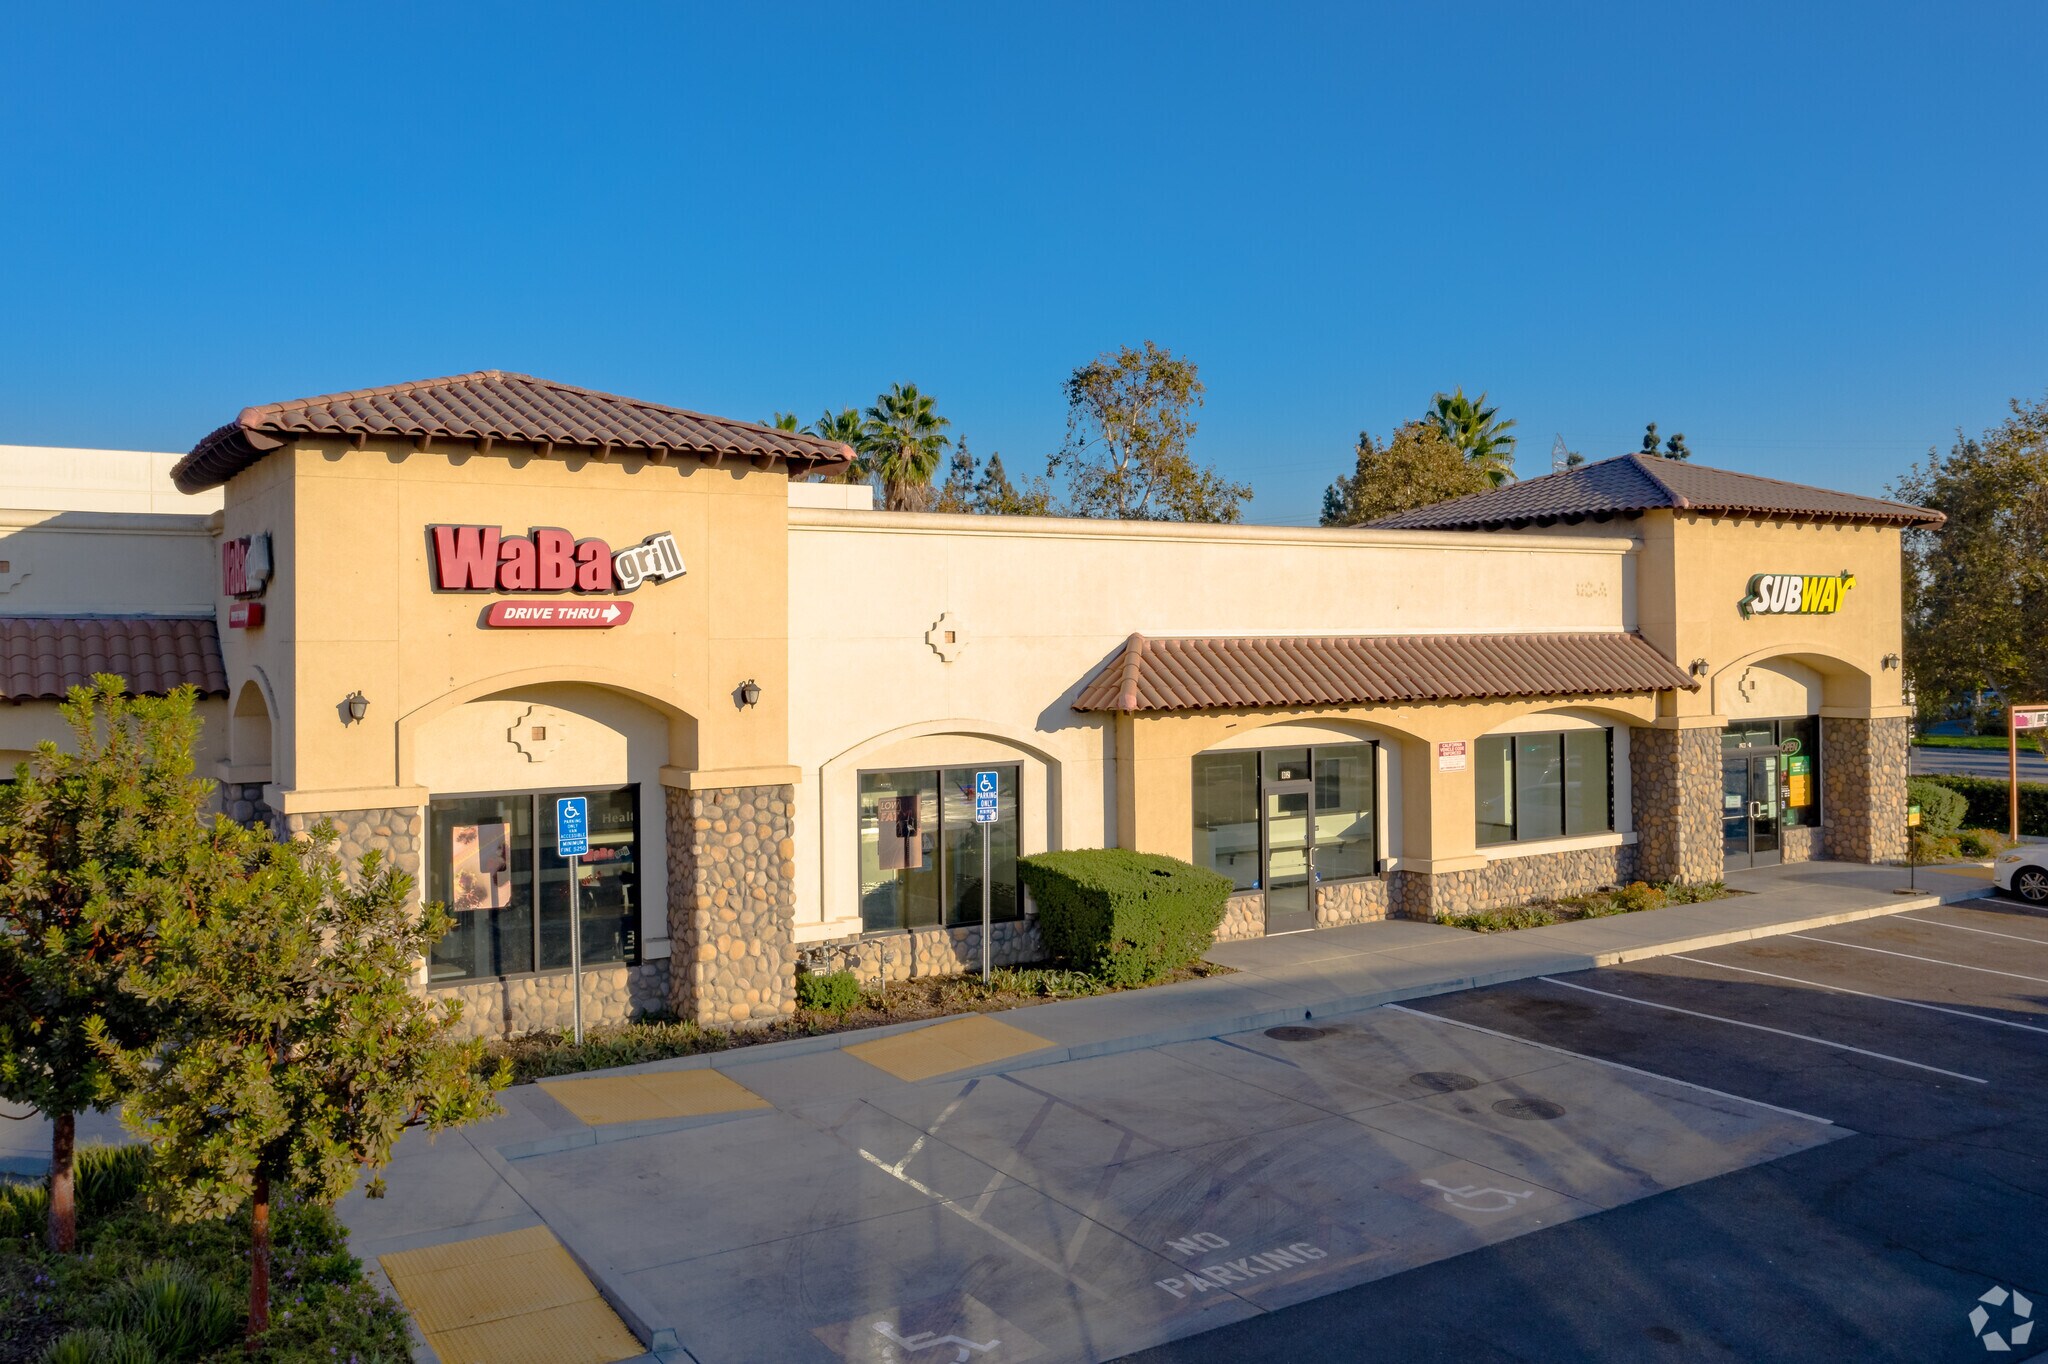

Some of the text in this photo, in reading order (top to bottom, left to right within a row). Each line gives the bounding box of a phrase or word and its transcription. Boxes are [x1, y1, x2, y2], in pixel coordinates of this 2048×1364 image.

[433, 526, 683, 592] WaBa grill
[503, 607, 600, 620] DRIVE THRU
[1751, 574, 1857, 614] SUBWAY
[1165, 1231, 1231, 1256] NO
[1154, 1242, 1328, 1300] PARKING
